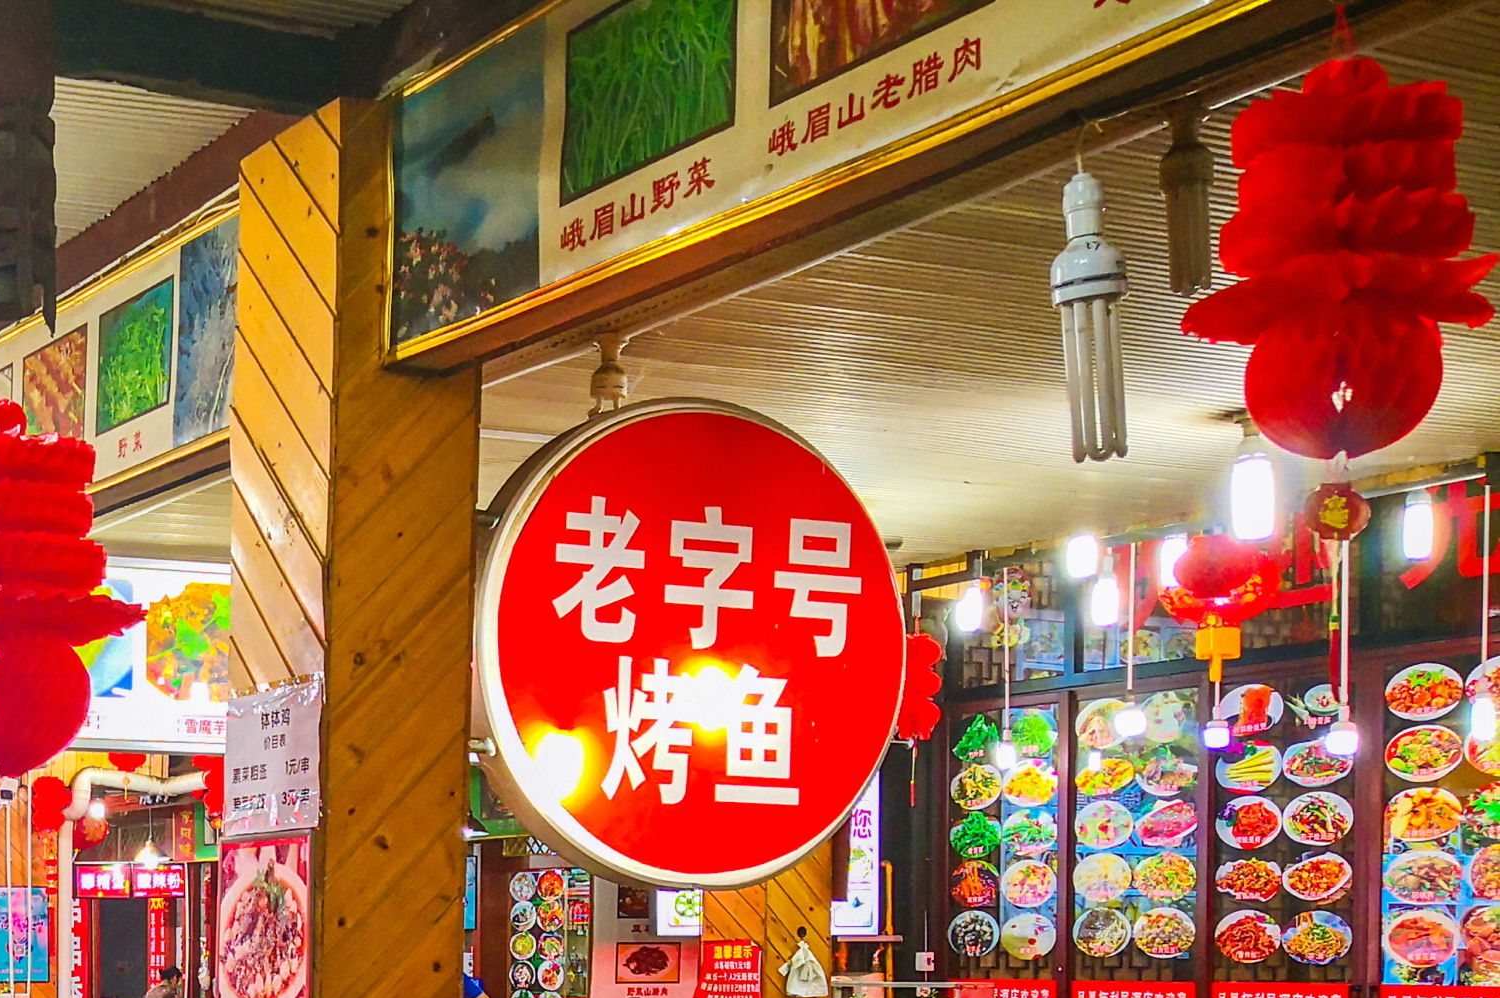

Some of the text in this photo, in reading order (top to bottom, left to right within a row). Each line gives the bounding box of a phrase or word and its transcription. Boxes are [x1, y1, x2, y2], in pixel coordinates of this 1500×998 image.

[768, 36, 983, 157] 峨眉山老腊肉
[559, 156, 715, 253] 峨眉山野菜
[118, 431, 142, 458] 野菜
[552, 496, 862, 658] 老字号
[263, 733, 286, 750] 价目表
[601, 655, 800, 806] 烤鱼
[852, 808, 872, 839] 您
